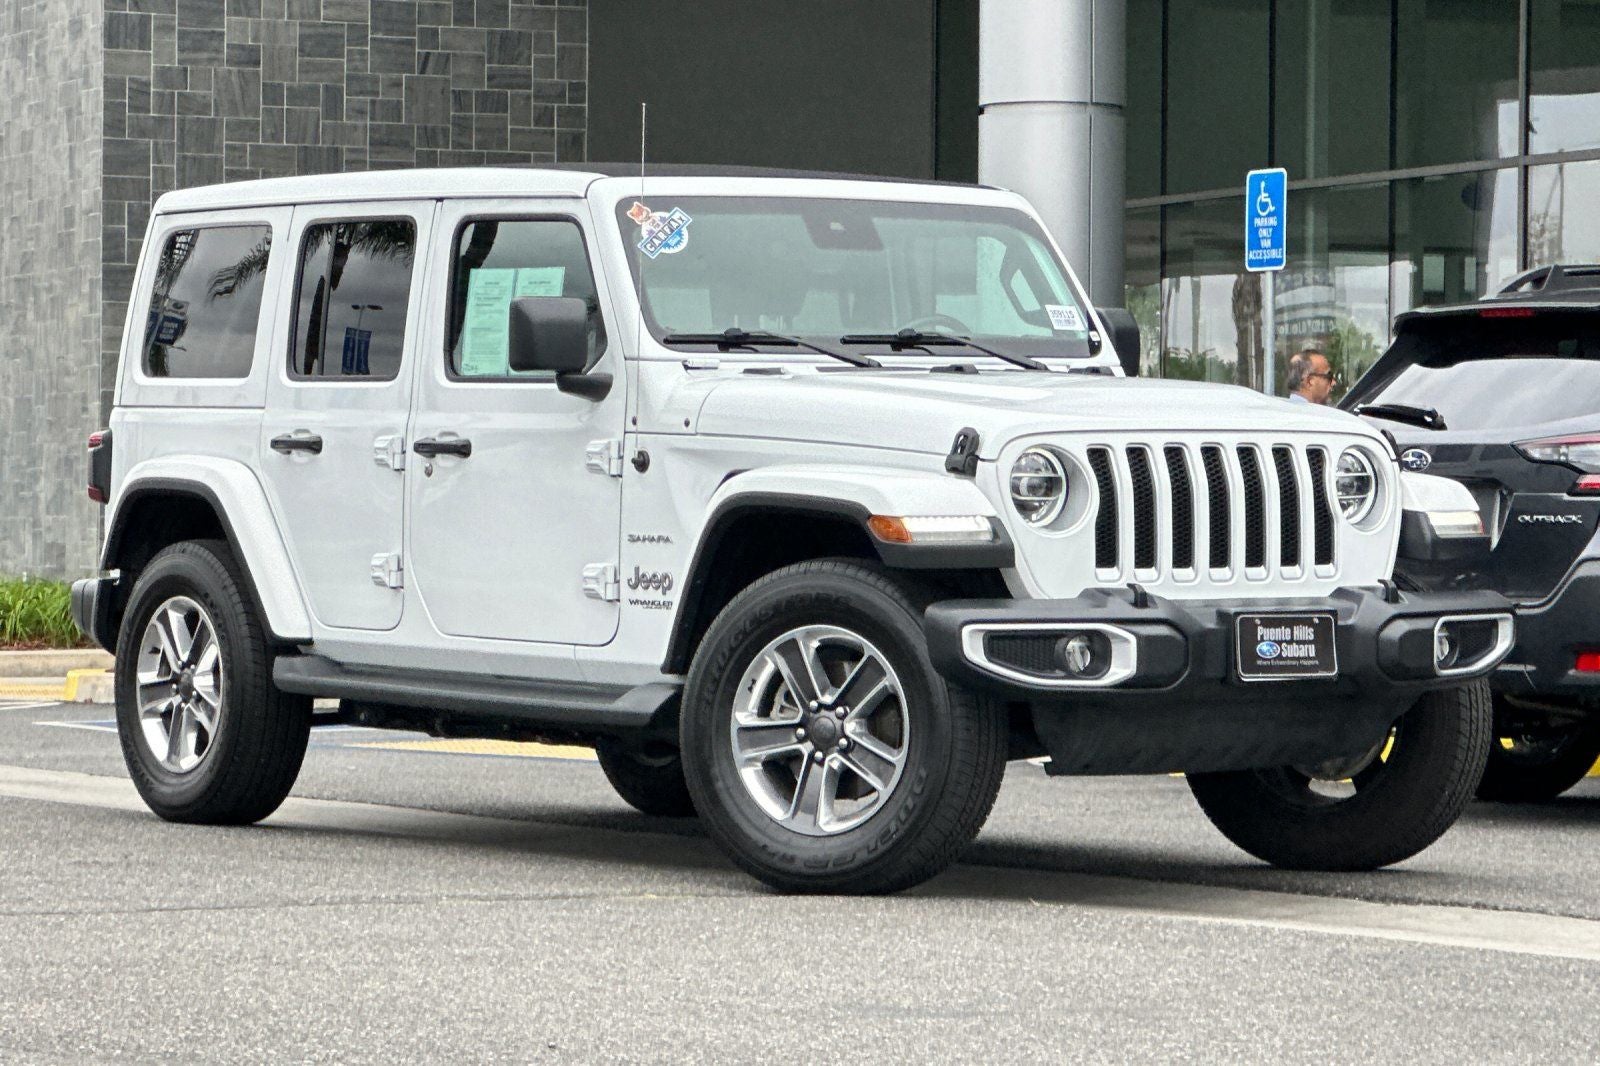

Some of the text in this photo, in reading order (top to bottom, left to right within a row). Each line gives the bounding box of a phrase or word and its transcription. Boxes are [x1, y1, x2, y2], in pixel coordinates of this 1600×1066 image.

[1254, 216, 1277, 228] PARKING
[644, 214, 685, 252] CARFAX
[1258, 227, 1273, 238] ONLY
[1260, 238, 1271, 248] VAN
[1248, 248, 1283, 260] ACCESSIBLE
[1518, 514, 1583, 524] OUTBACK
[627, 534, 673, 544] SAHARA
[627, 566, 673, 596] Jeep
[628, 599, 673, 607] WRANGLER
[1257, 624, 1315, 641] Puente Hills
[1281, 642, 1316, 658] Subaru
